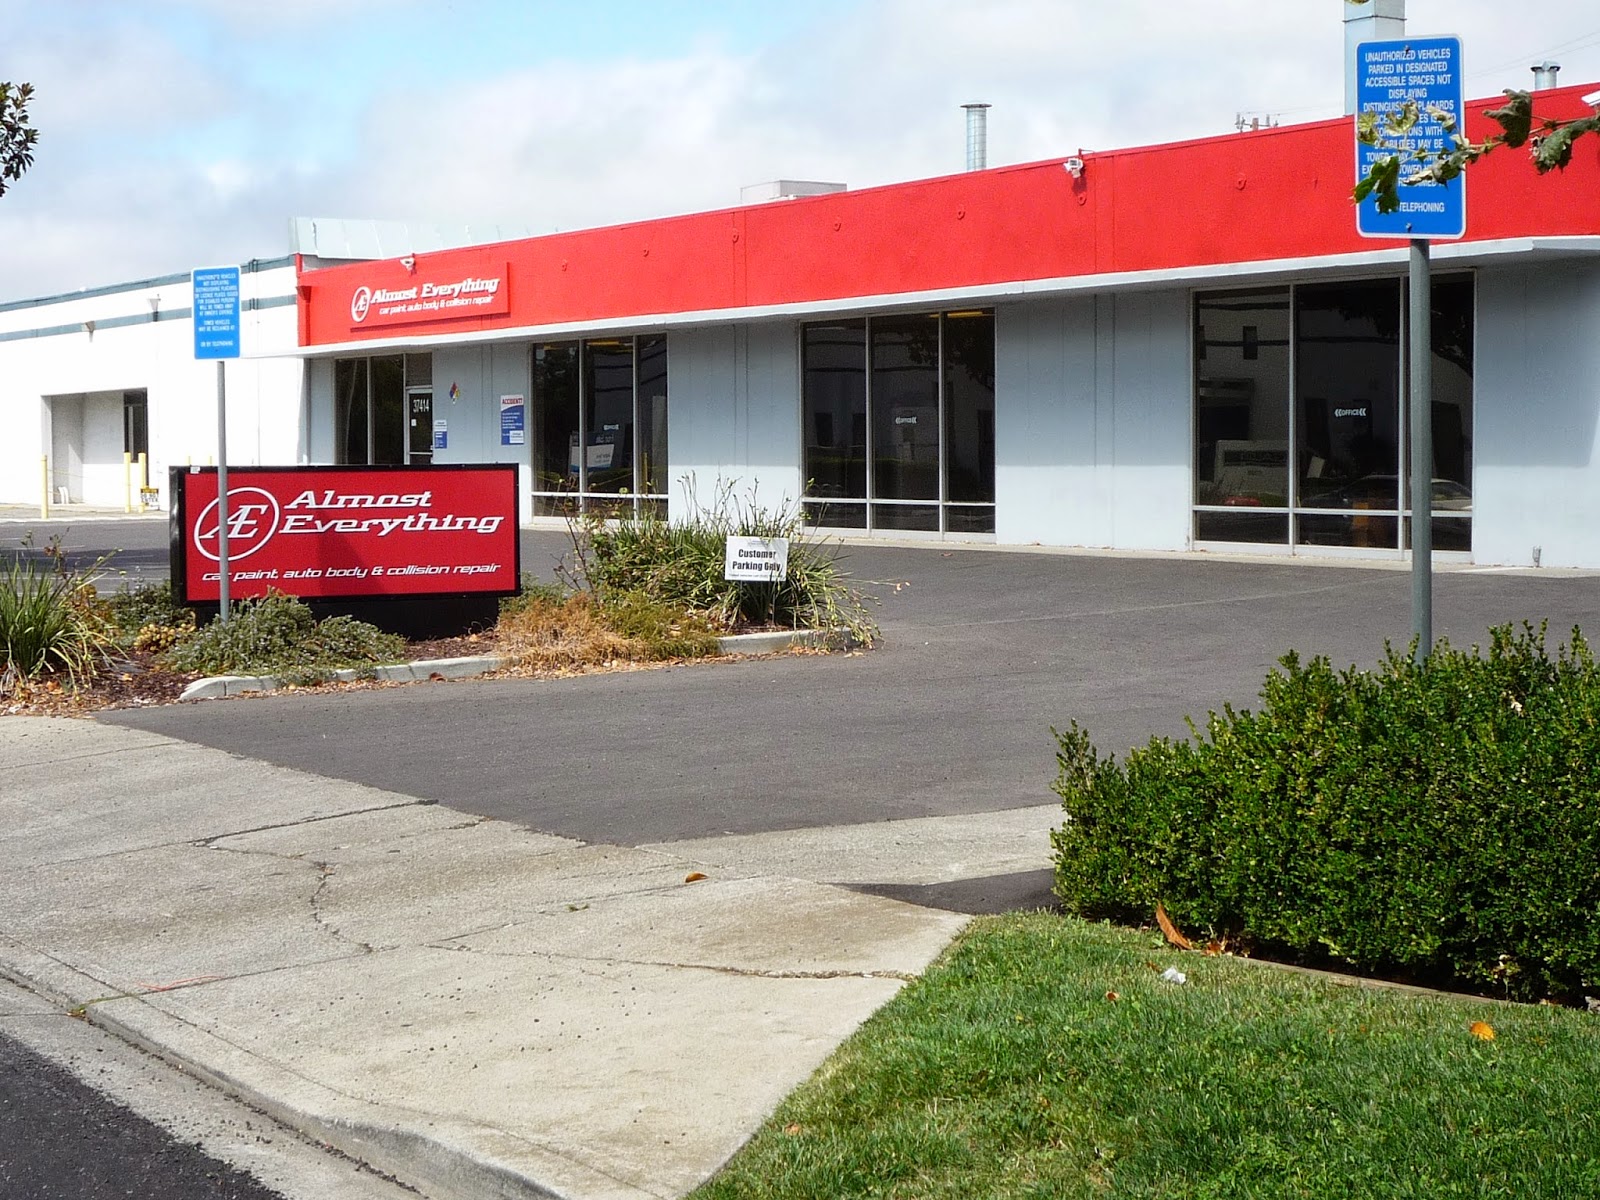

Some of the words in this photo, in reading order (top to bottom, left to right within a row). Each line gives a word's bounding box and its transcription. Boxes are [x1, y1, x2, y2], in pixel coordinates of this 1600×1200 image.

[1365, 50, 1415, 62] UNAUTHORIZED
[1418, 48, 1451, 60] VEHICLES
[1369, 64, 1394, 74] PARKED
[1396, 64, 1403, 73] IN
[1406, 62, 1447, 73] DESIGNATED
[1365, 76, 1406, 87] ACCESSIBLE
[1408, 75, 1435, 86] SPACES
[1437, 74, 1452, 84] NOT
[1389, 88, 1427, 99] DISPLAYING
[1425, 126, 1443, 136] WITH
[1418, 138, 1431, 149] MAY
[1434, 138, 1443, 148] BE
[1399, 202, 1445, 213] TELEPHONING
[370, 287, 418, 304] Almost
[421, 278, 500, 298] Everything
[407, 301, 423, 312] auto
[423, 300, 439, 310] body
[440, 299, 446, 308] &
[446, 297, 472, 307] collision
[472, 295, 494, 305] repair
[413, 399, 429, 412] 37414
[284, 490, 432, 509] Almost
[279, 513, 504, 536] Everything
[738, 549, 777, 558] Customer
[283, 569, 322, 578] auto
[325, 567, 368, 579] body
[371, 566, 384, 576] &
[386, 565, 449, 576] collision
[453, 563, 501, 575] repair
[732, 561, 763, 571] Parking
[764, 562, 781, 571] Only
